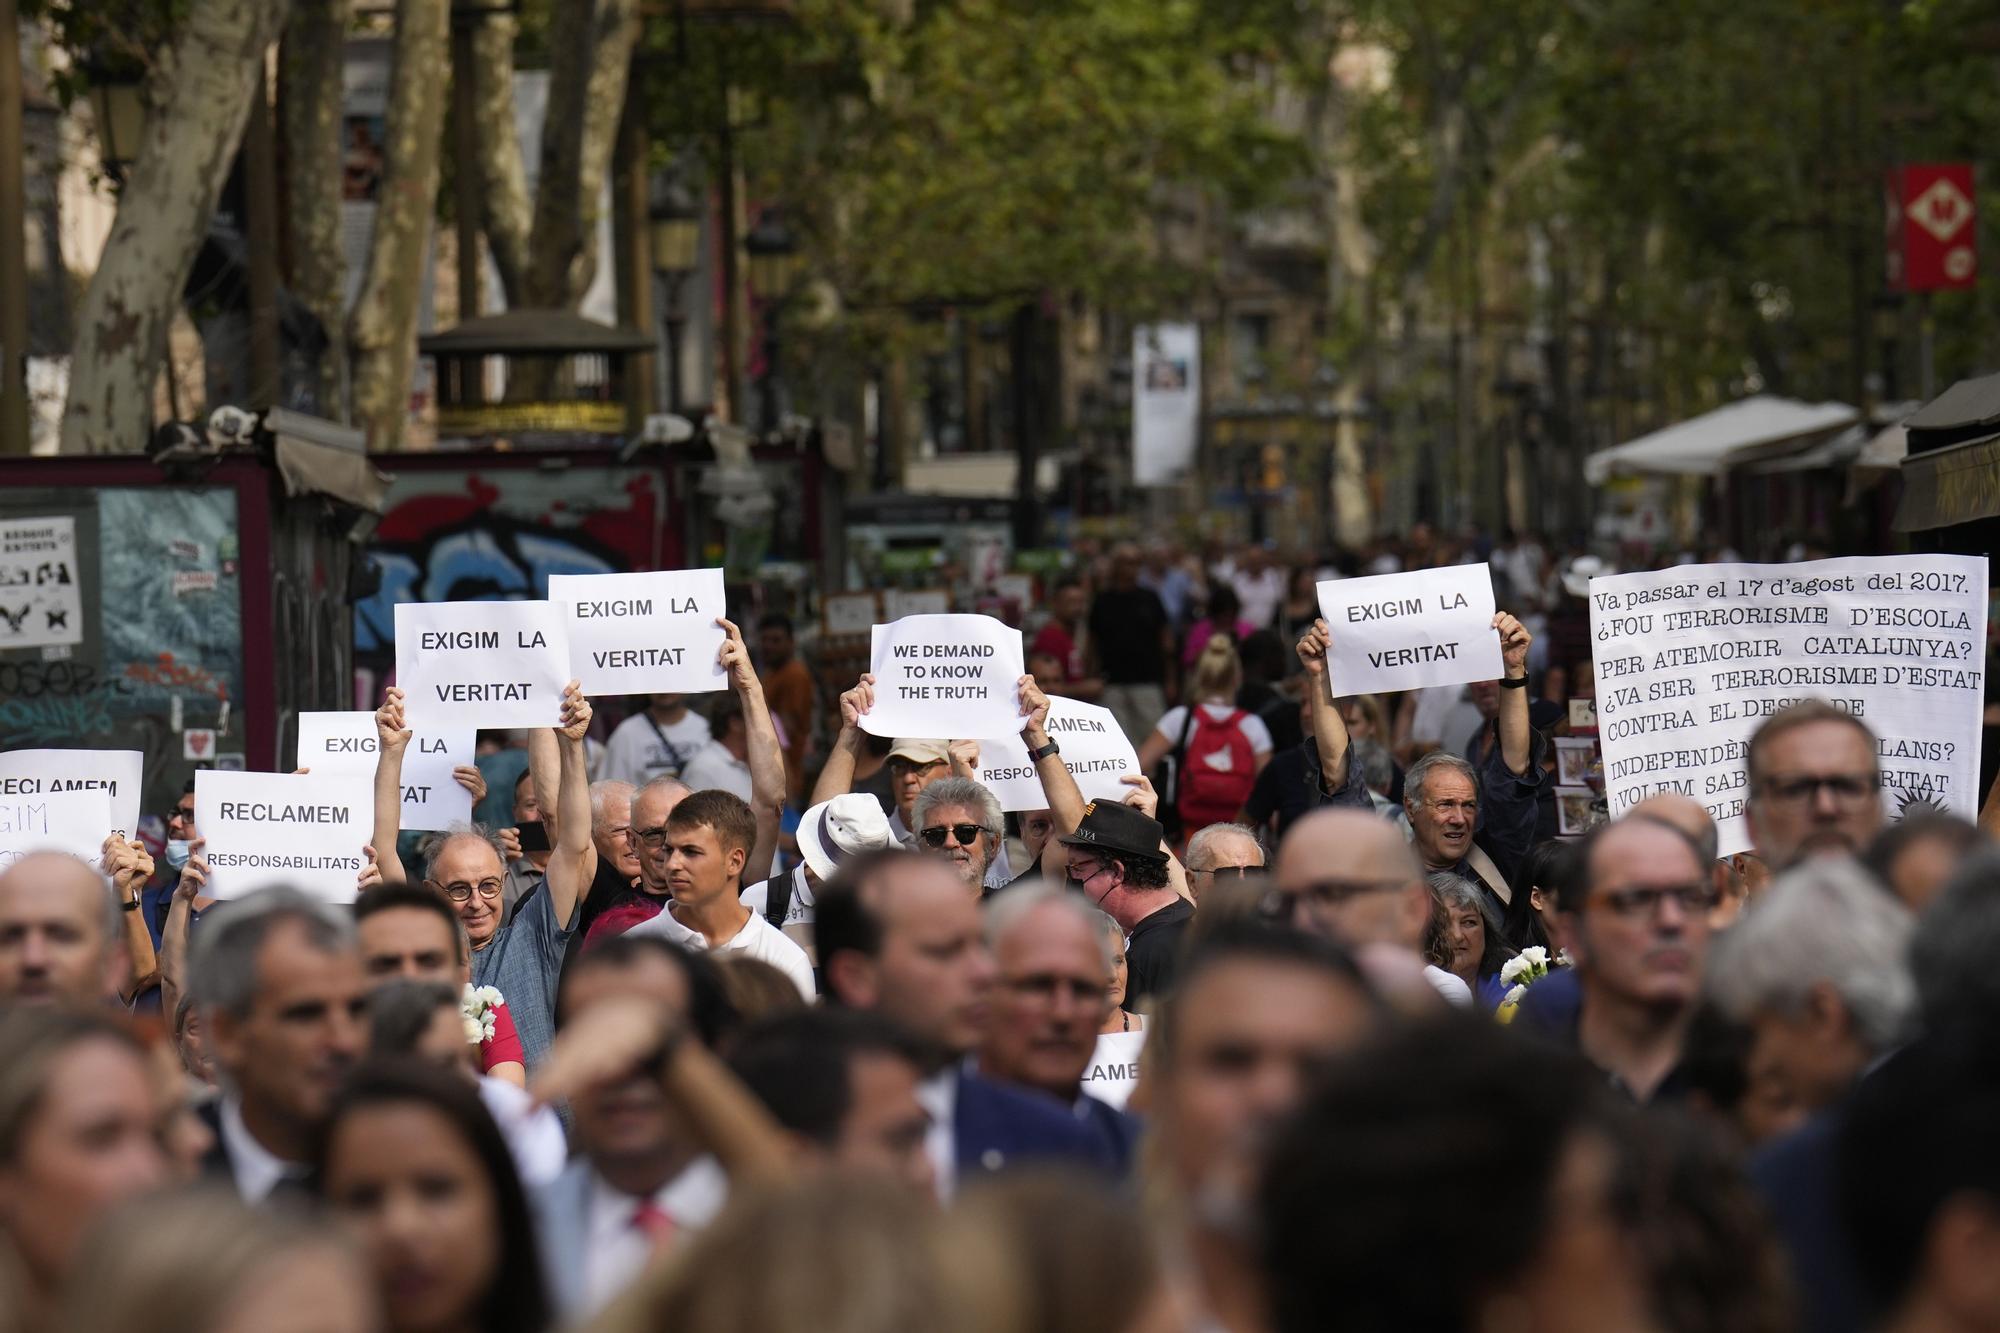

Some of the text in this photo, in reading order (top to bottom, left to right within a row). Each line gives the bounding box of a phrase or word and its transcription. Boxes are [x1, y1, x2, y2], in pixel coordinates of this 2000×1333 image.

[1594, 592, 1621, 612] Va
[1625, 583, 1699, 611] passar
[1707, 581, 1727, 598] el
[1738, 580, 1763, 597] 17
[1867, 573, 1903, 590] del
[1910, 572, 1969, 594] 2017.
[576, 597, 699, 618] EXIGIM LA
[1347, 592, 1469, 623] EXIGIM LA
[1597, 614, 1653, 641] ¿FOU
[1663, 607, 1828, 632] TERRORISME
[421, 630, 547, 650] EXIGIM LA
[593, 648, 686, 669] VERITAT
[893, 645, 994, 658] WE DEMAND
[1368, 642, 1459, 669] VERITAT
[1600, 637, 1972, 680] PER ATEMORIR CATALUNYA?
[903, 665, 983, 678] TO KNOW
[435, 683, 532, 702] VERITAT
[898, 686, 988, 700] THE TRUTH
[1605, 687, 1643, 713] ¿VA
[1649, 678, 1696, 701] SER
[1711, 667, 1877, 691] TERRORISME
[1607, 710, 1698, 742] CONTRA
[1709, 702, 1737, 723] EL
[1830, 698, 1865, 717] DE
[420, 738, 447, 754] LA
[0, 778, 117, 797] ECLAMEM
[220, 802, 350, 824] RECLAMEM
[207, 853, 360, 870] RESPONSABILITATS
